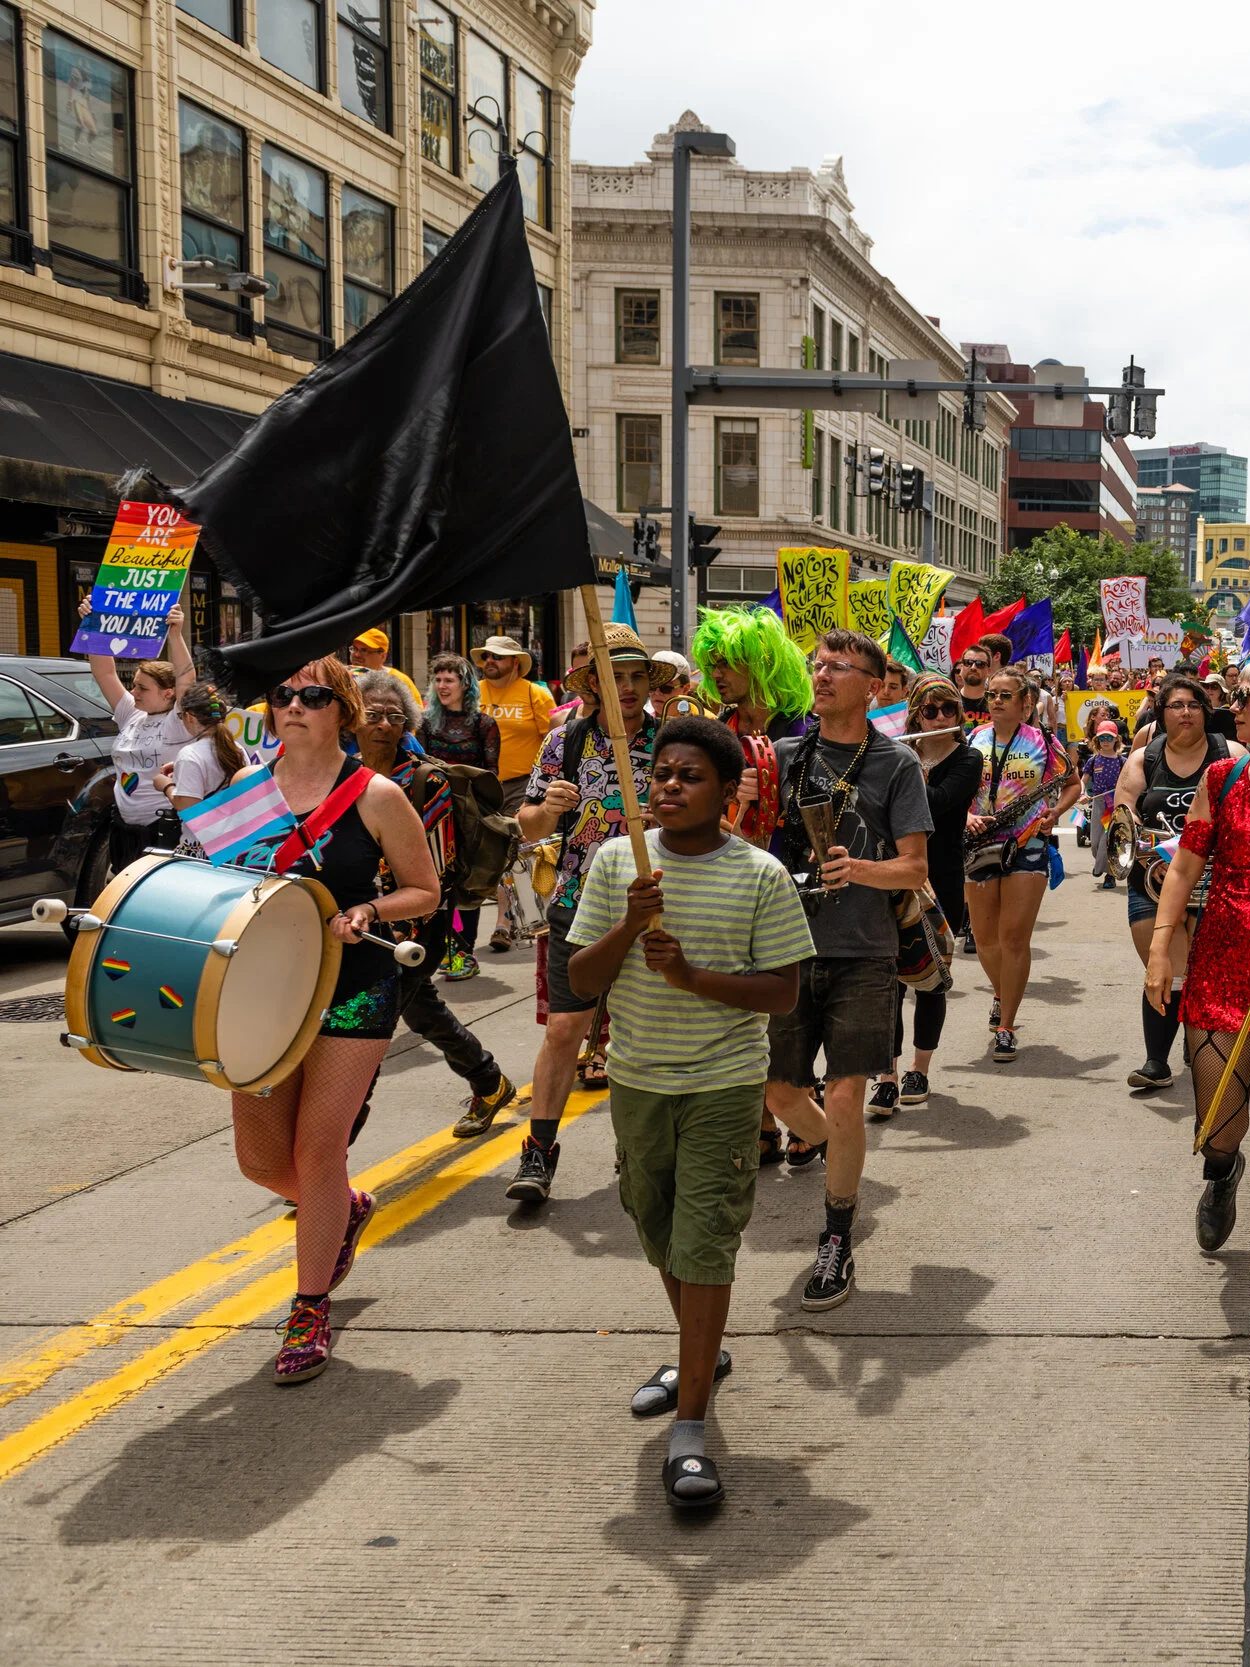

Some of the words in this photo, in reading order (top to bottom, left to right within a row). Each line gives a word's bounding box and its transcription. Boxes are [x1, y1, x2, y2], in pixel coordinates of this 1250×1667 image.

[147, 506, 181, 526] YOU
[136, 527, 175, 547] ARE
[109, 547, 192, 568] Beautiful
[120, 568, 170, 588] JUST
[806, 554, 839, 583] COPS
[1103, 580, 1141, 599] ROOTS
[104, 591, 138, 609] THE
[140, 592, 171, 612] WAY
[1106, 597, 1140, 616] RAGE
[100, 614, 130, 633] YOU
[130, 617, 163, 637] ARE
[1146, 644, 1180, 652] FACULTY
[1084, 699, 1110, 707] Grads
[130, 749, 161, 768] Not
[1006, 770, 1036, 780] ROLES
